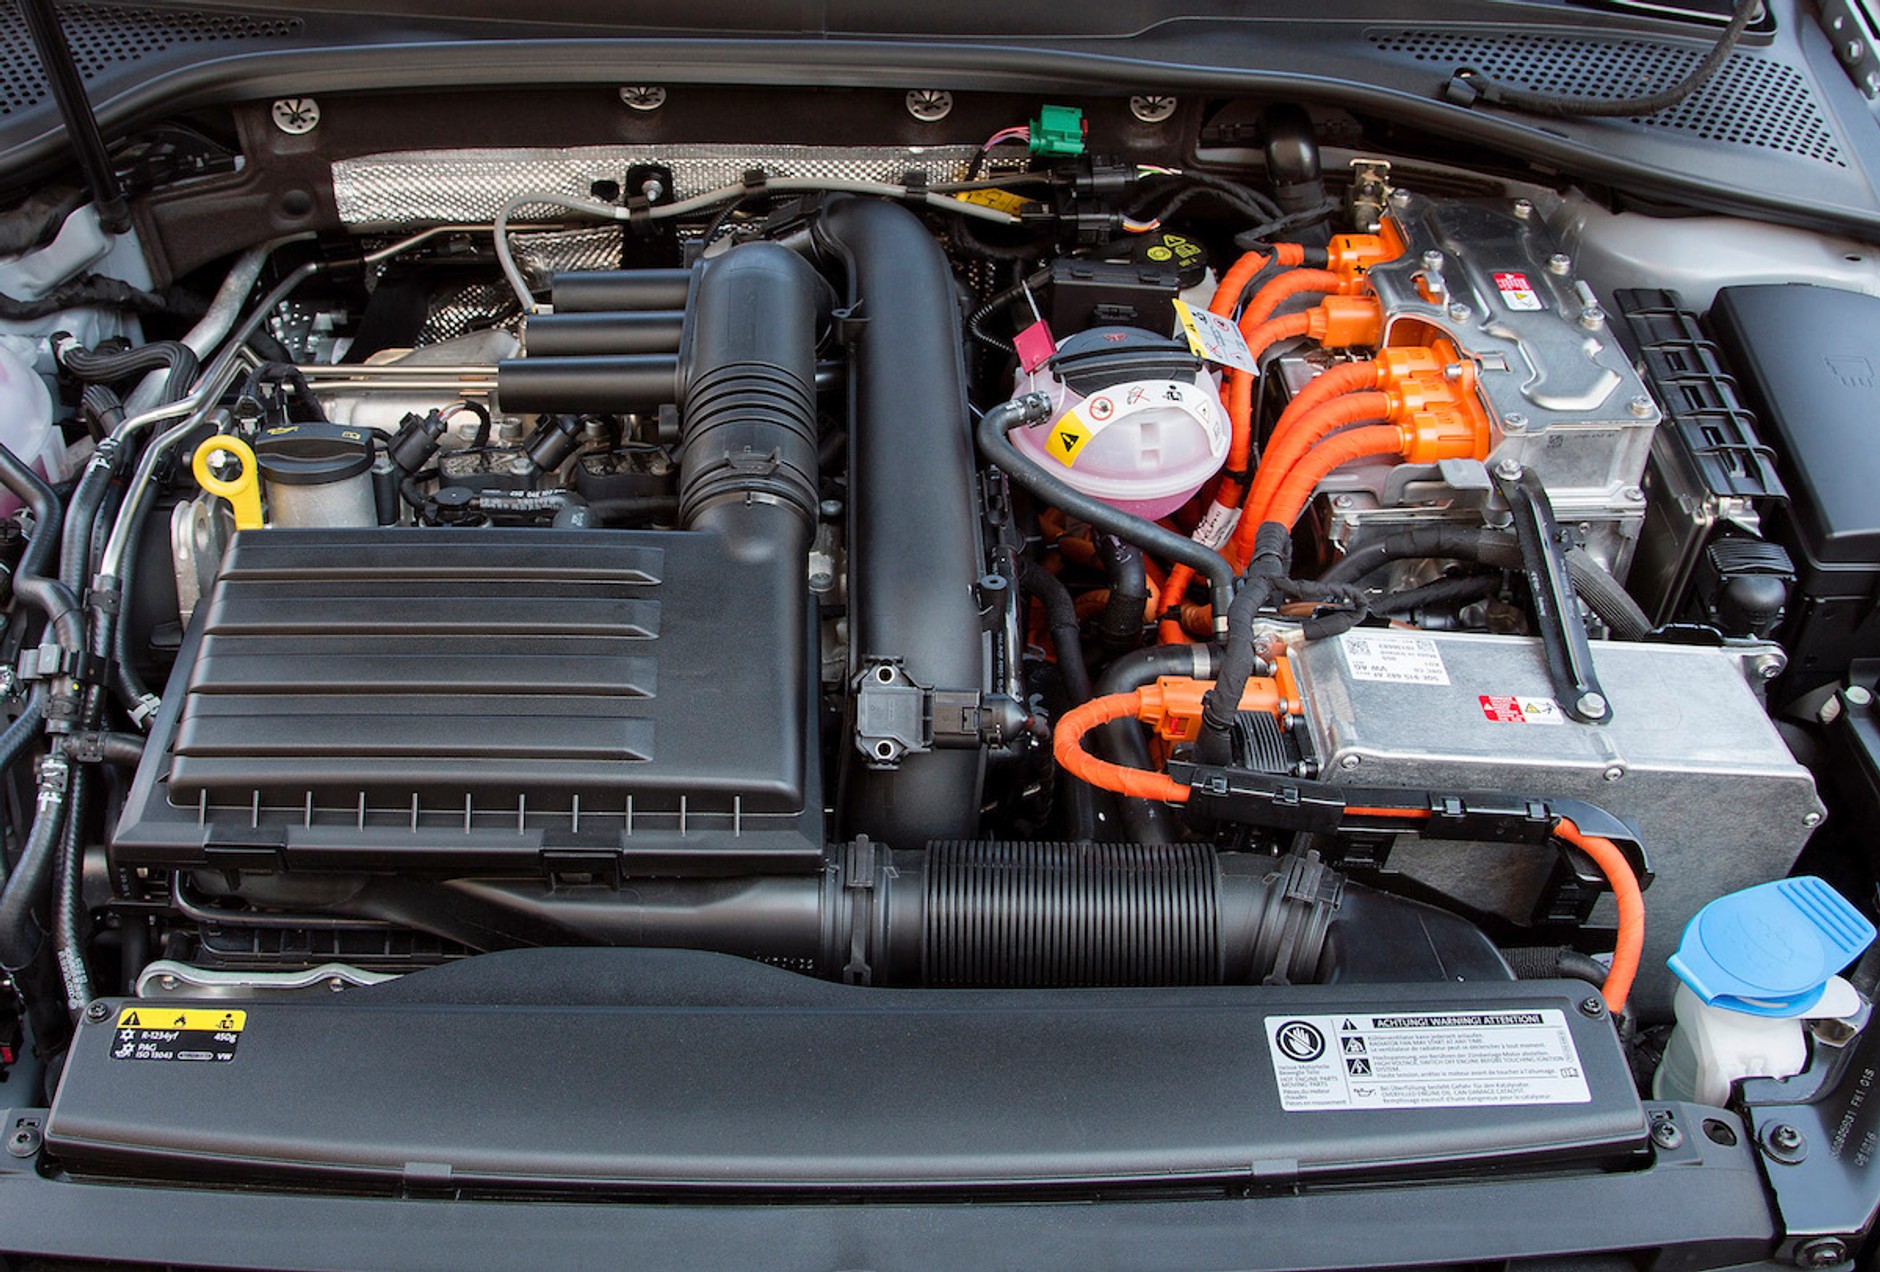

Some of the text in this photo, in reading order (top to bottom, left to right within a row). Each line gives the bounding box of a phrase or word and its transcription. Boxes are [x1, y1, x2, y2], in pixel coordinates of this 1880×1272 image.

[1377, 1014, 1541, 1027] ACHTUNG! WARNING! ATTENTION!
[141, 1031, 179, 1043] R-1234yf
[213, 1032, 237, 1043] 450g
[138, 1043, 157, 1051] PAG
[134, 1051, 150, 1059] ISO
[151, 1051, 174, 1059] 13043
